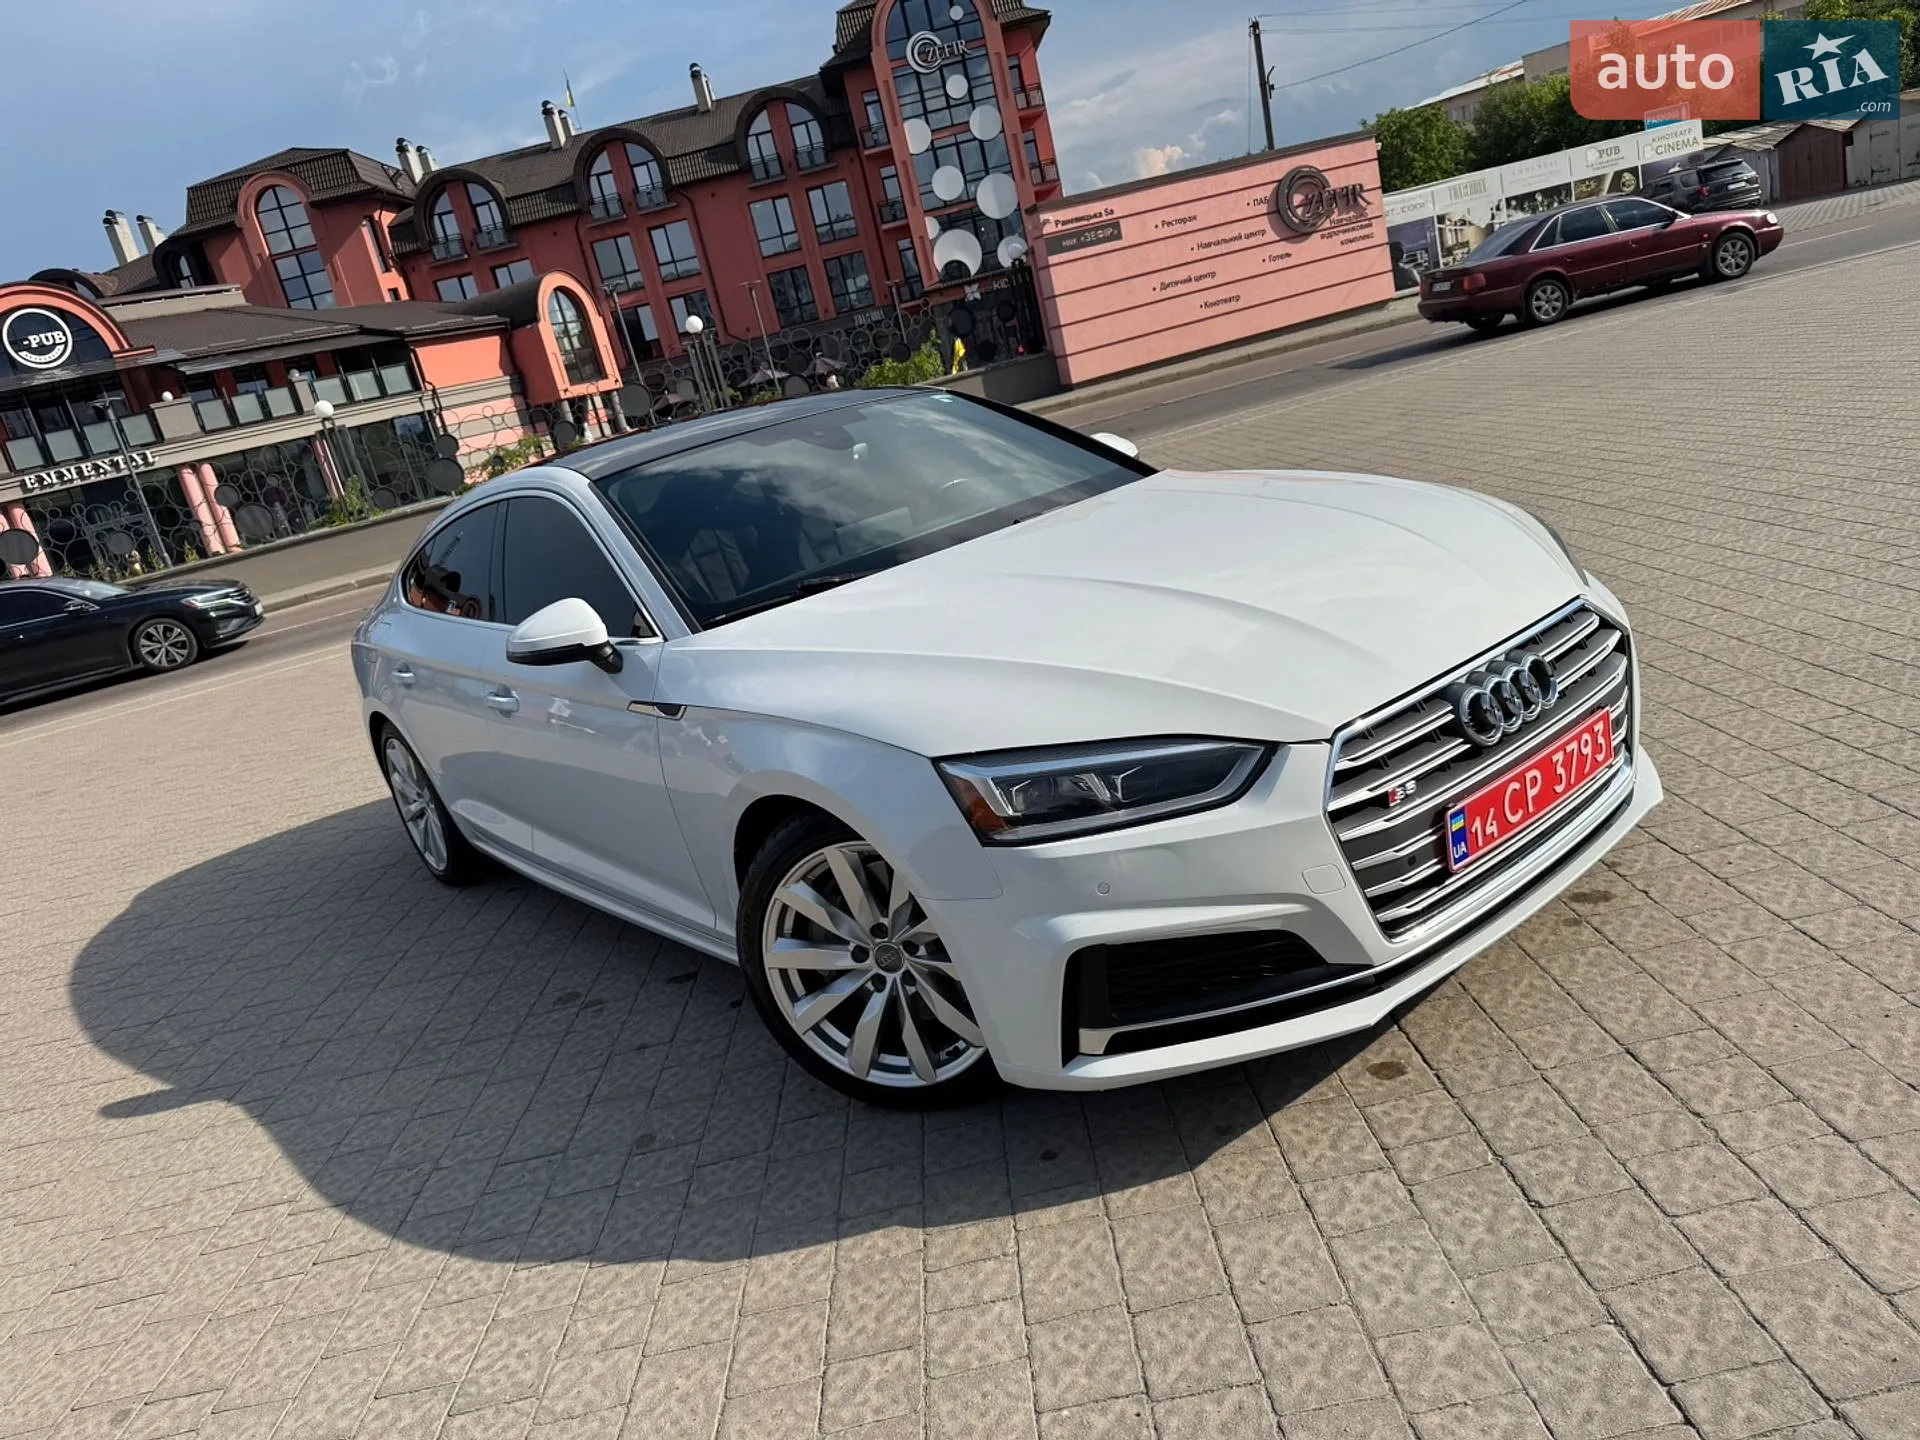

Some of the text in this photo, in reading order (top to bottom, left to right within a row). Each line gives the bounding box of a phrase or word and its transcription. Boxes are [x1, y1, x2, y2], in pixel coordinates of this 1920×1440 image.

[926, 40, 972, 62] ZEFIR
[1599, 146, 1621, 158] PUB
[1655, 136, 1700, 155] CINEMA
[1161, 214, 1198, 228] Ресторан
[1197, 229, 1267, 250] Навчальний центр
[1340, 233, 1375, 246] комплекс
[1268, 252, 1293, 263] Готель
[1160, 271, 1217, 292] Дитячий центр
[1204, 294, 1241, 309] Кінотеатр
[24, 450, 159, 488] EMMENTAL
[1471, 721, 1606, 847] 14 CP 3793
[1453, 843, 1468, 858] UA
